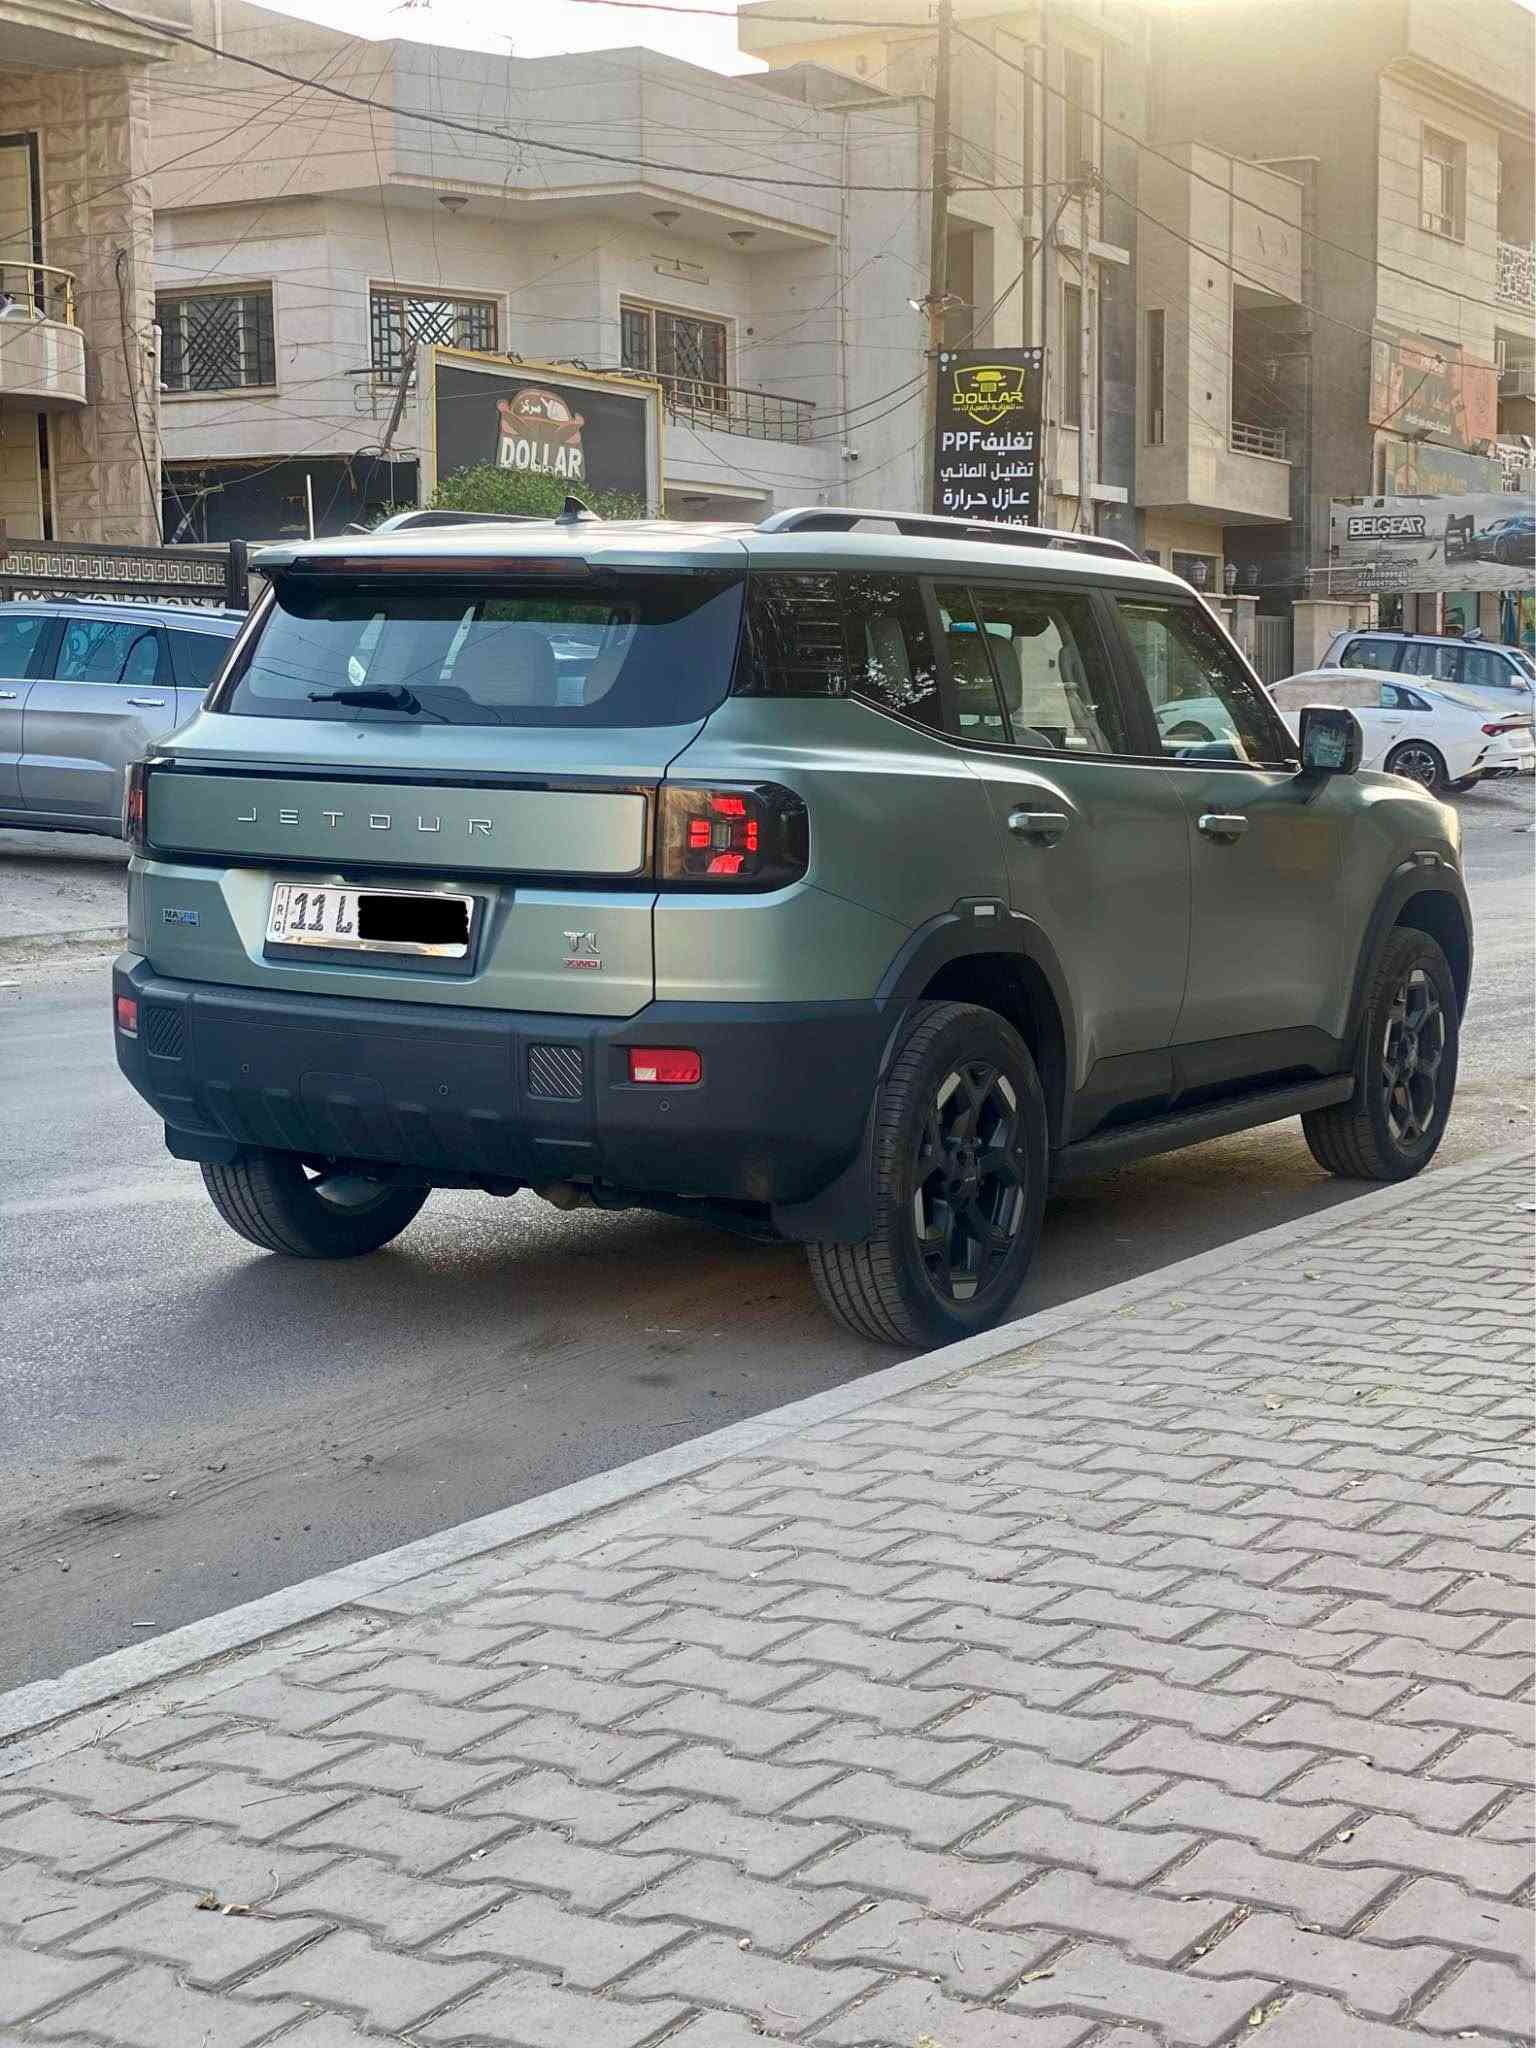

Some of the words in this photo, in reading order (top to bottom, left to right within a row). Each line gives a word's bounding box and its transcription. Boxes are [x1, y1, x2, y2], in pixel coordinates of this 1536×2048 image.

[953, 392, 1024, 404] DOLLAR
[942, 431, 981, 451] PPF
[981, 432, 1033, 456] تغليف
[500, 437, 583, 478] DOLLAR
[940, 463, 986, 481] الماني
[991, 461, 1034, 481] تضليل
[943, 488, 988, 510] حرارة
[992, 487, 1029, 510] عازل
[1349, 516, 1424, 535] BELGEAR
[238, 808, 492, 835] JETOUR
[291, 892, 325, 931] 11
[335, 895, 353, 933] L
